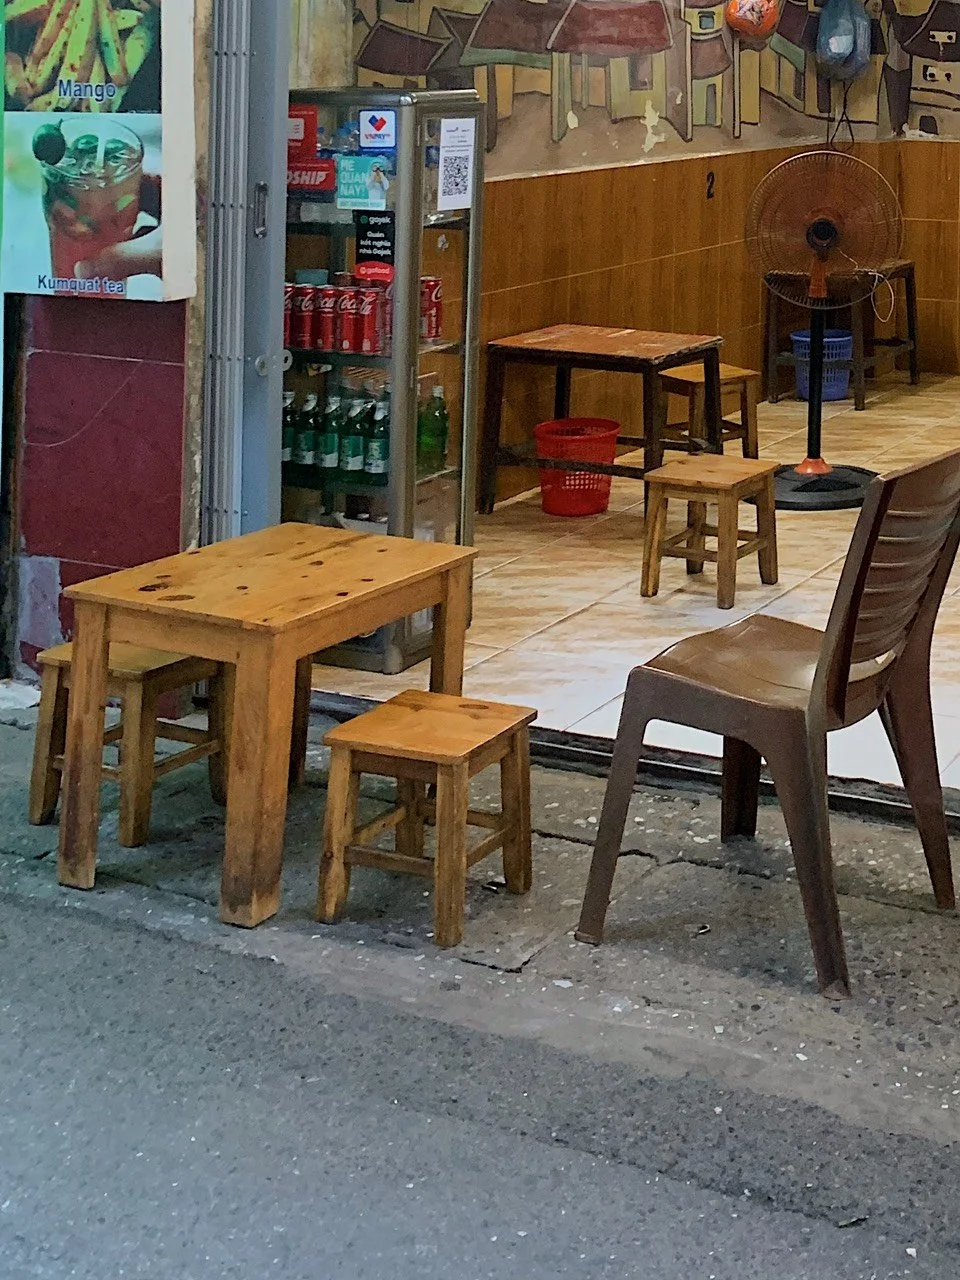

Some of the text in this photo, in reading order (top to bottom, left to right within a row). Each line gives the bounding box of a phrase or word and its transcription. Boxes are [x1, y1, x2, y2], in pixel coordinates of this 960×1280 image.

[58, 79, 117, 102] Mango
[706, 171, 716, 199] 2
[38, 274, 125, 295] Kumquat tea
